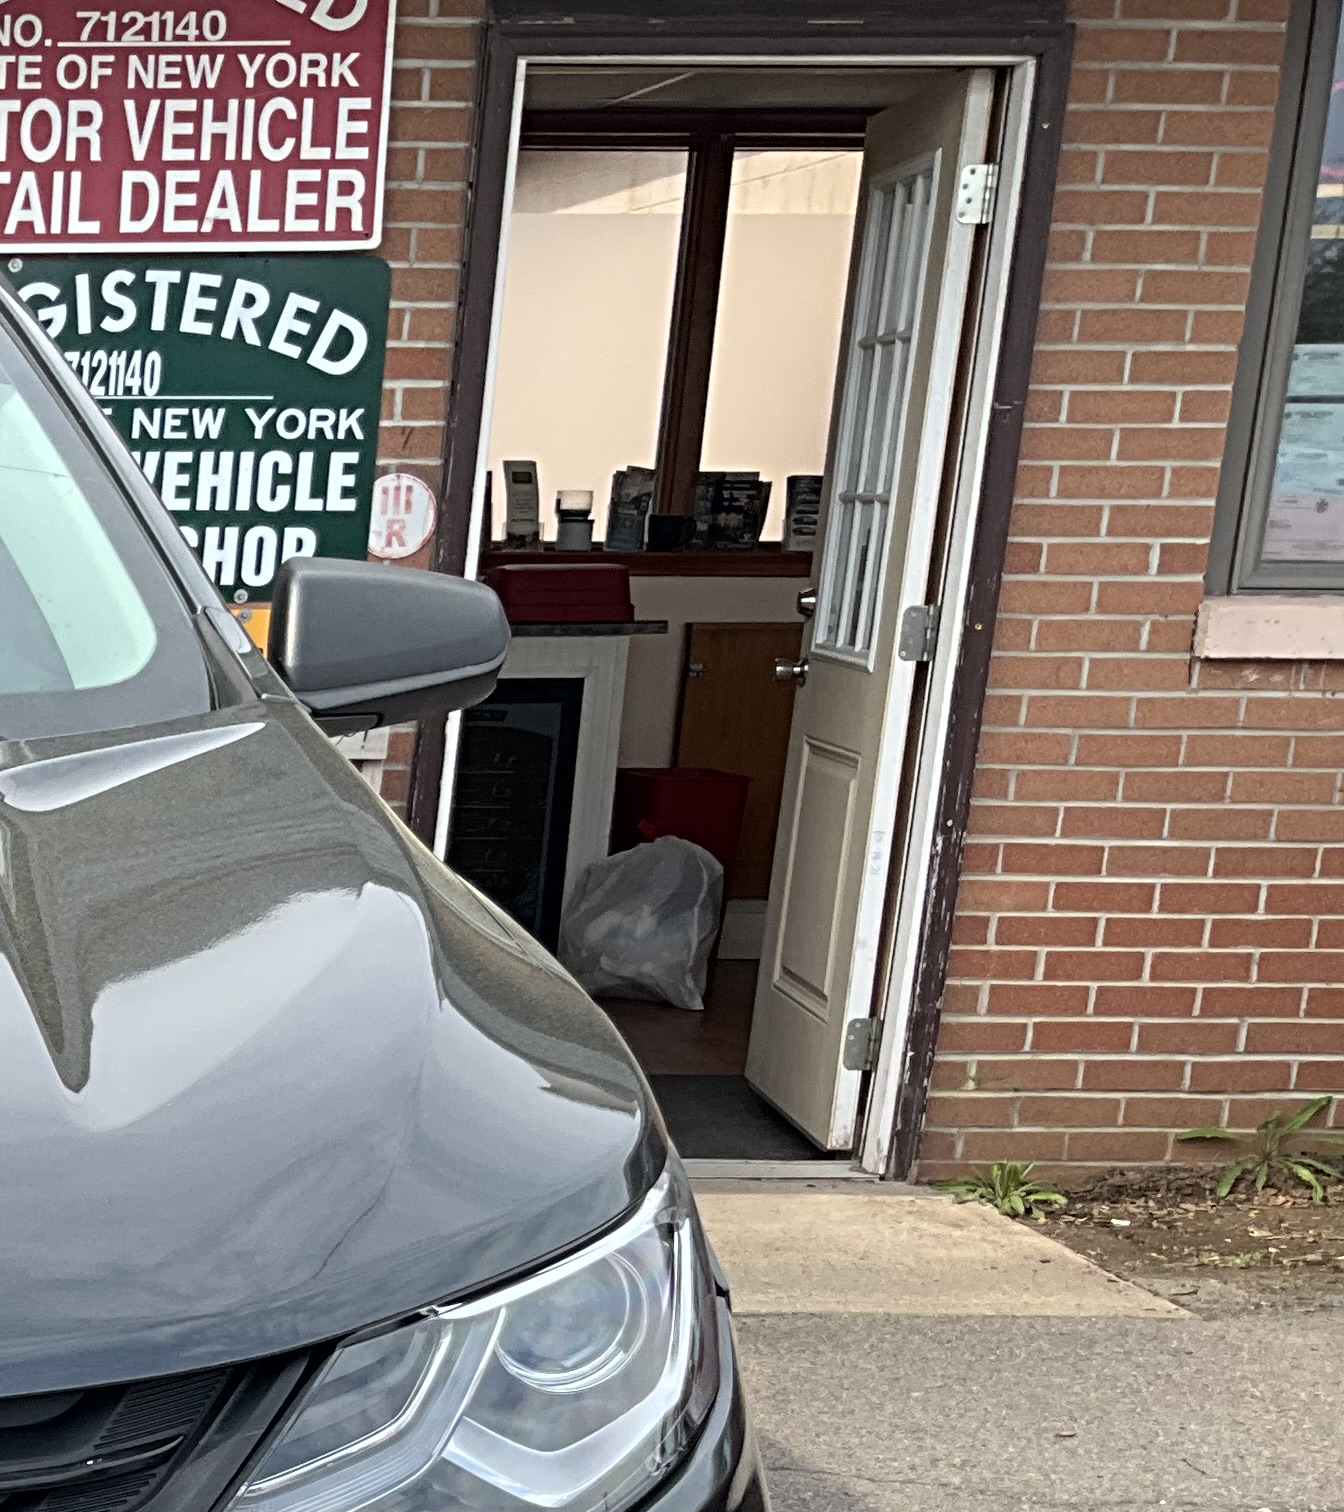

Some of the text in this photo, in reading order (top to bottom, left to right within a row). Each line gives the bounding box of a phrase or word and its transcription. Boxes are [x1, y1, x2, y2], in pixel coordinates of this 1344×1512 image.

[76, 10, 227, 42] 7121140
[56, 54, 115, 90] OF
[127, 54, 224, 89] NEW
[237, 52, 360, 88] YORK
[123, 97, 372, 162] VEHICLE
[119, 169, 366, 234] DEALER
[17, 269, 368, 376] GISTERED
[131, 407, 365, 439] NEW YORK
[384, 518, 407, 548] R
